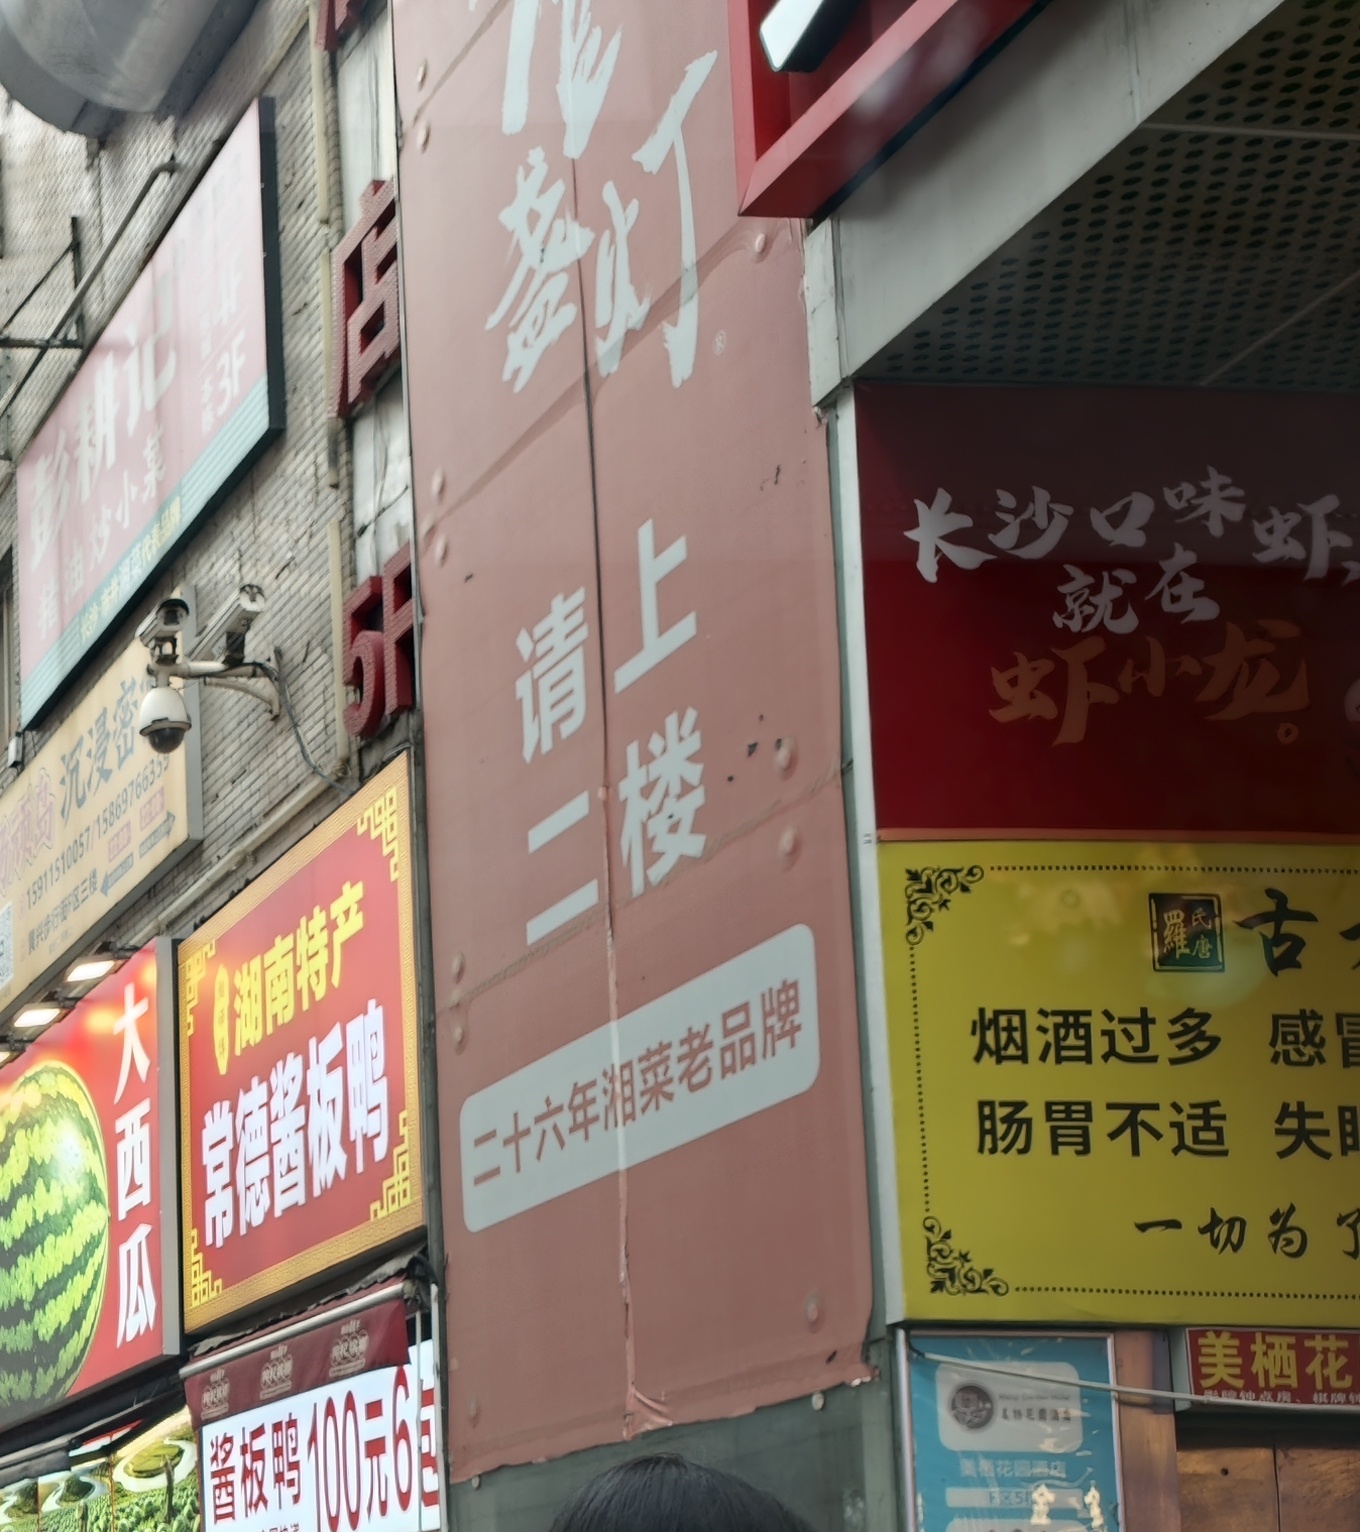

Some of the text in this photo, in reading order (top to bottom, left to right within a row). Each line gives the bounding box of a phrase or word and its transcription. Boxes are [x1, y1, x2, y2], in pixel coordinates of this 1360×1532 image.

[515, 518, 697, 764] 请上
[1052, 543, 1221, 635] 就在
[60, 672, 153, 827] 沉浸密
[525, 705, 707, 946] 二楼
[234, 880, 364, 1057] 湖南特产
[1233, 888, 1360, 976] 古
[473, 977, 802, 1188] 二十六年湘菜老品牌
[969, 1007, 1223, 1066] 烟酒过多
[112, 981, 157, 1349] 大西瓜
[201, 997, 389, 1249] 常德酱板鸭
[976, 1099, 1230, 1158] 肠胃不适
[1134, 1201, 1360, 1261] 一切为了
[1198, 1330, 1353, 1391] 美栖花
